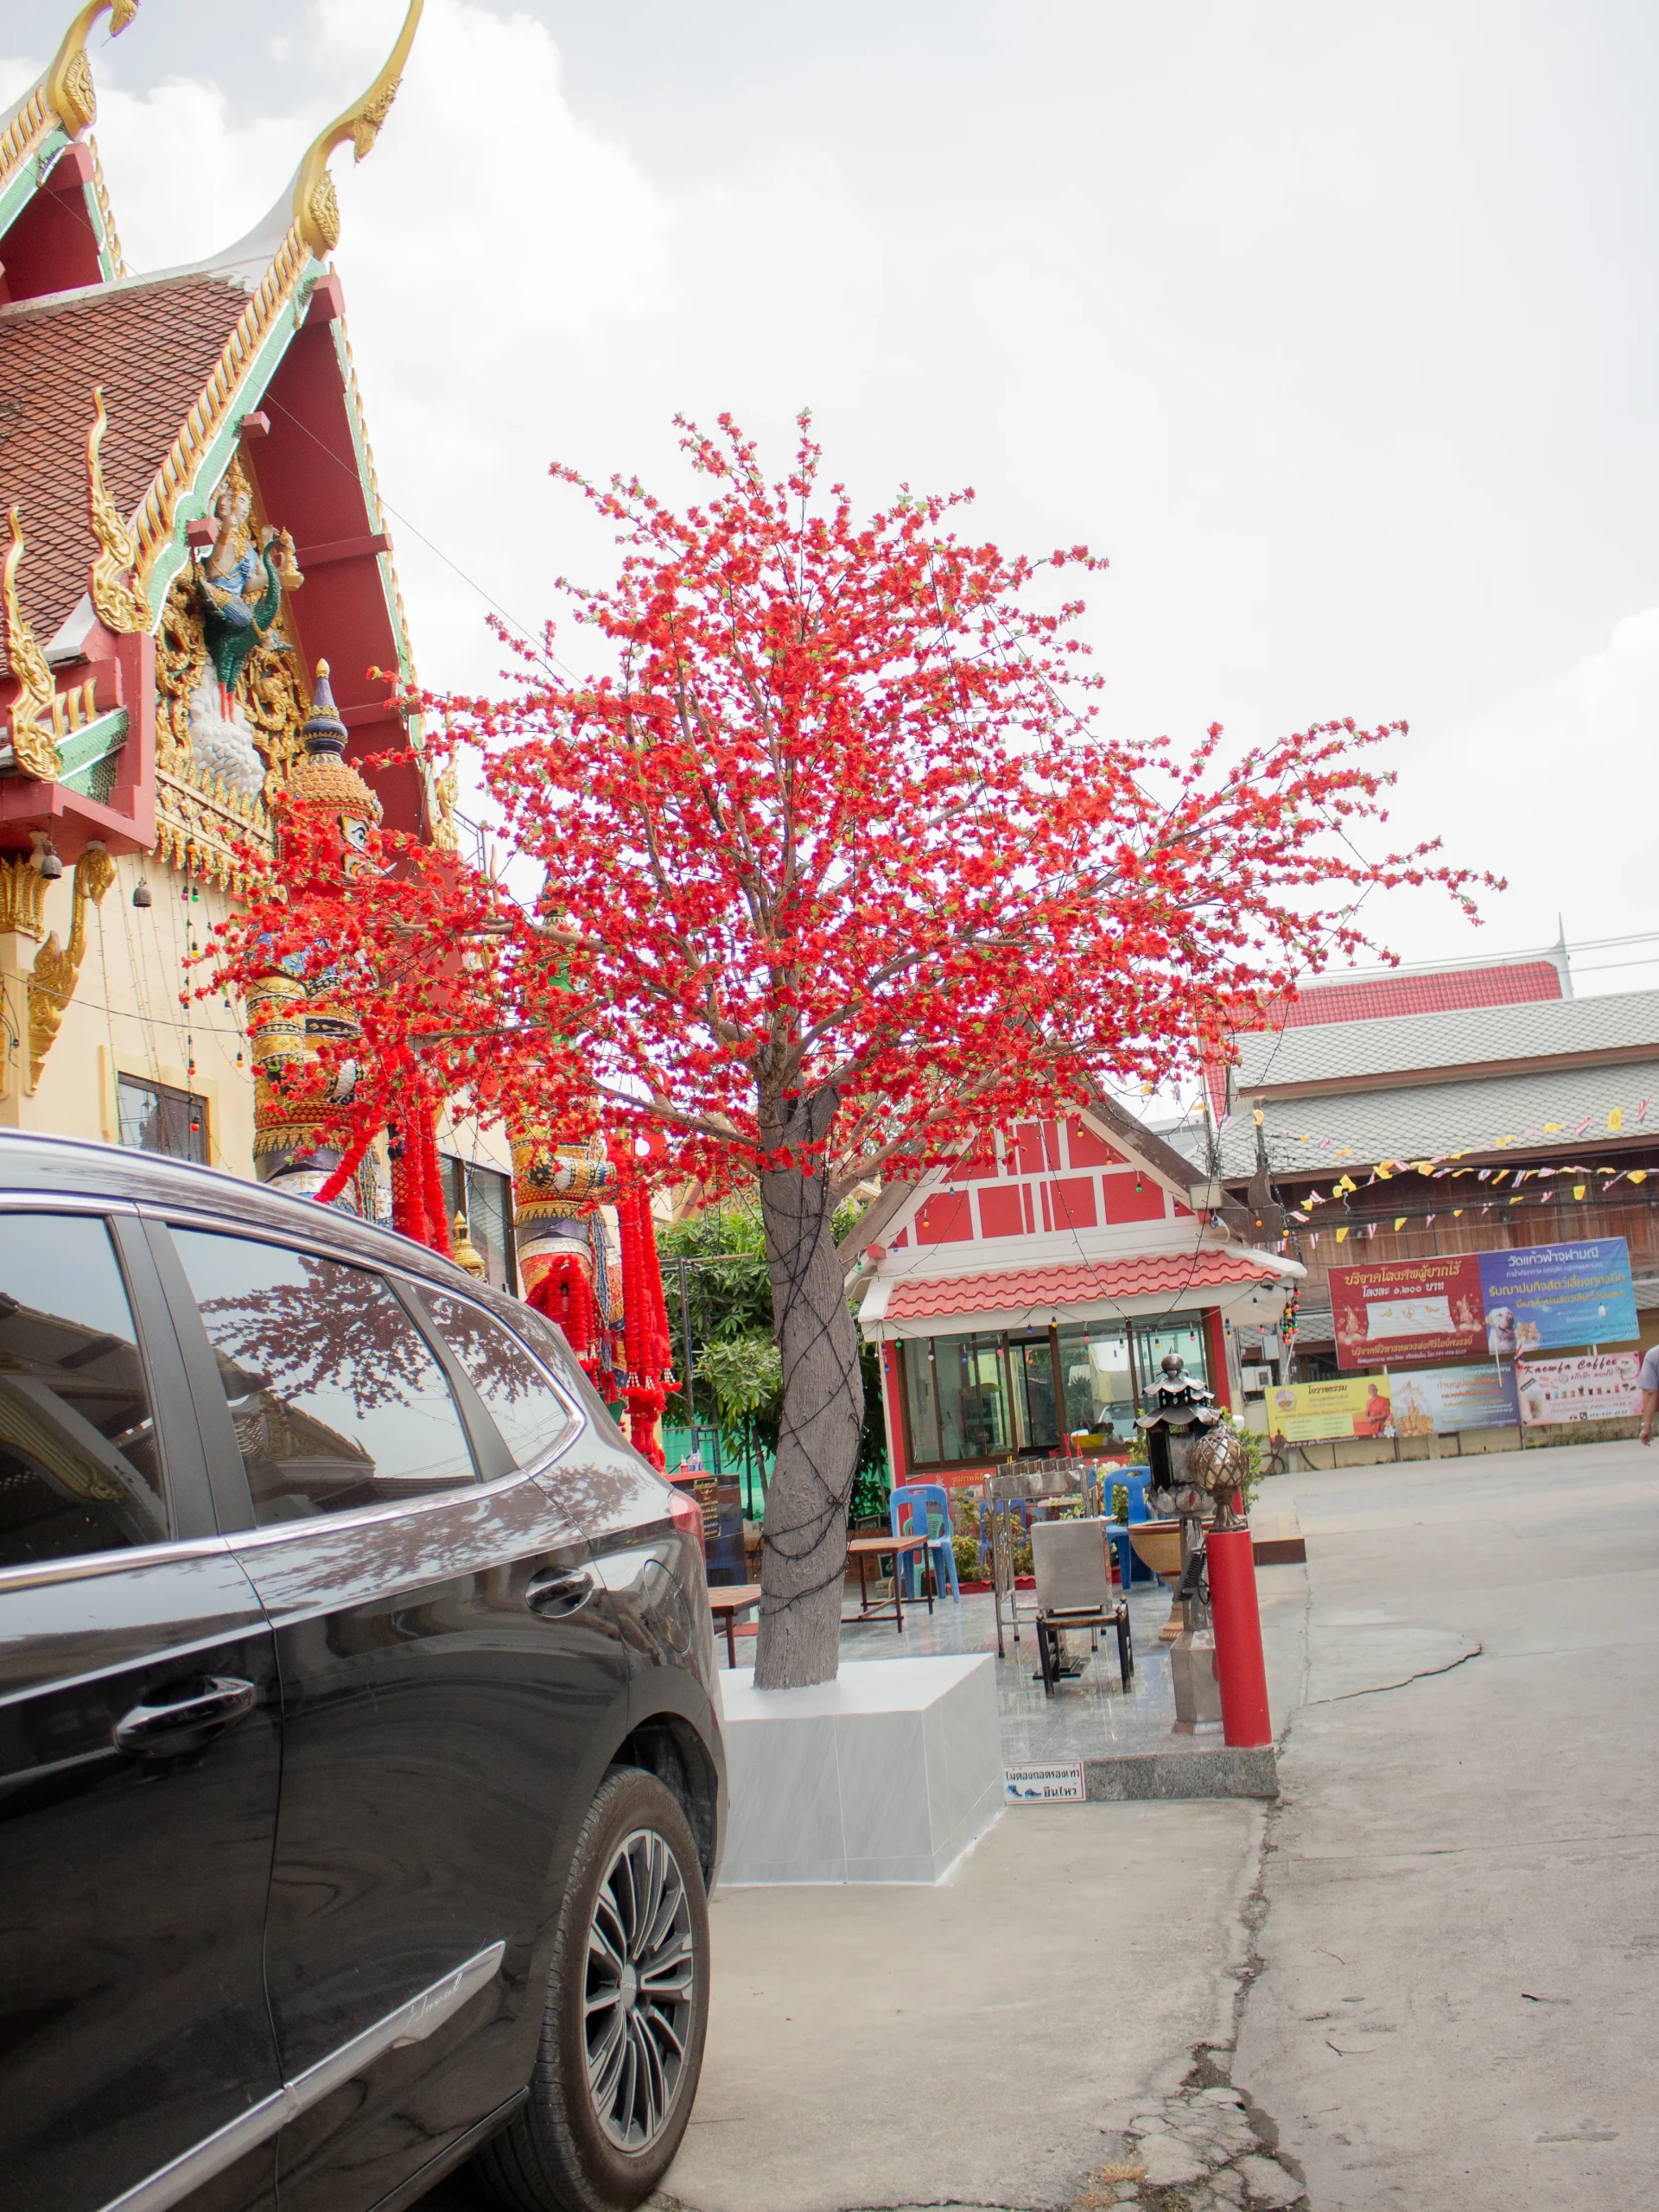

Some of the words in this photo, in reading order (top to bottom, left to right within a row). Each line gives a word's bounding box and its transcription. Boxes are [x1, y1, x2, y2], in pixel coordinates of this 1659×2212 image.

[1577, 1357, 1618, 1370] Coffee
[1005, 1764, 1080, 1781] ไม่ต้องถอดรองเท้า
[1043, 1782, 1077, 1797] ยืนไหว้
